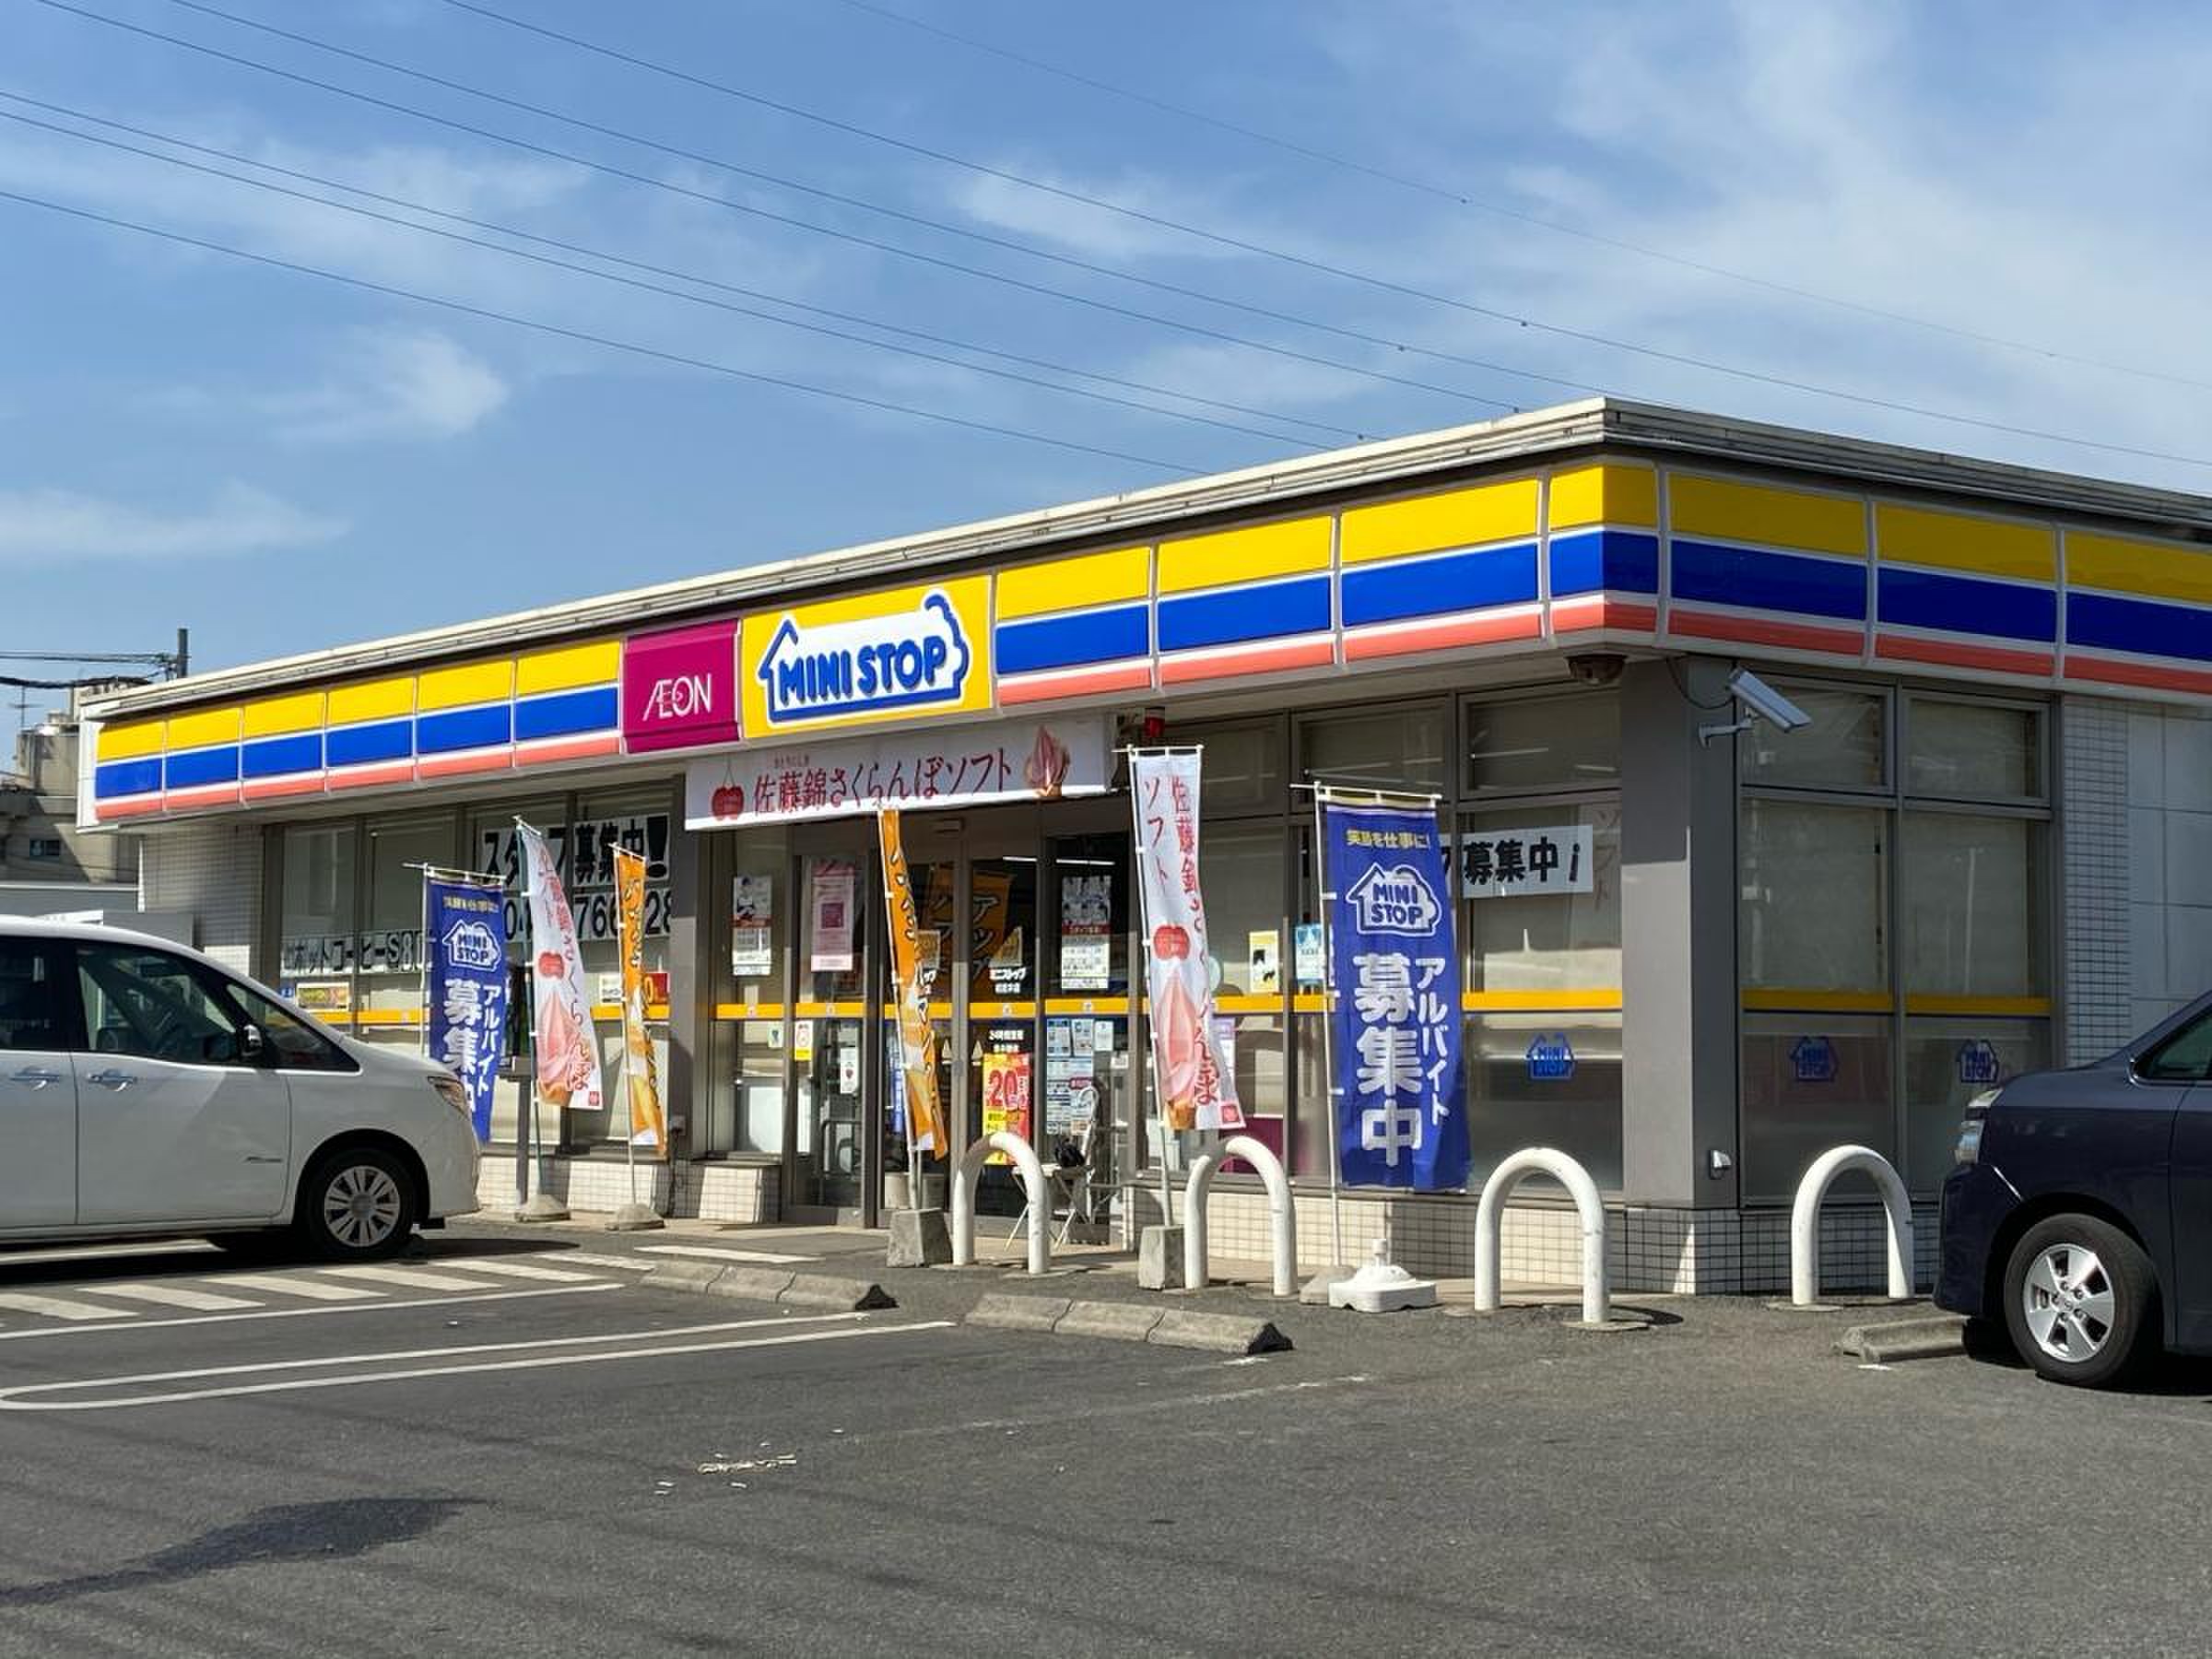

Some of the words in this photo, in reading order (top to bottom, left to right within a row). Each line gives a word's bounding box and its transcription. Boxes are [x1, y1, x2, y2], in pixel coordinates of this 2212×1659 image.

[778, 650, 853, 707] MINI
[857, 635, 947, 697] STOP
[750, 747, 1012, 817] 佐藤錦さくらんぼソフト
[1145, 777, 1169, 896] ソフト
[1371, 882, 1418, 904] MINI
[1371, 903, 1424, 925] STOP
[457, 934, 488, 948] MINI
[457, 947, 488, 963] STOP
[477, 985, 502, 1097] アルバイト
[1352, 953, 1423, 1167] 募集中
[1415, 958, 1451, 1125] アルバイト
